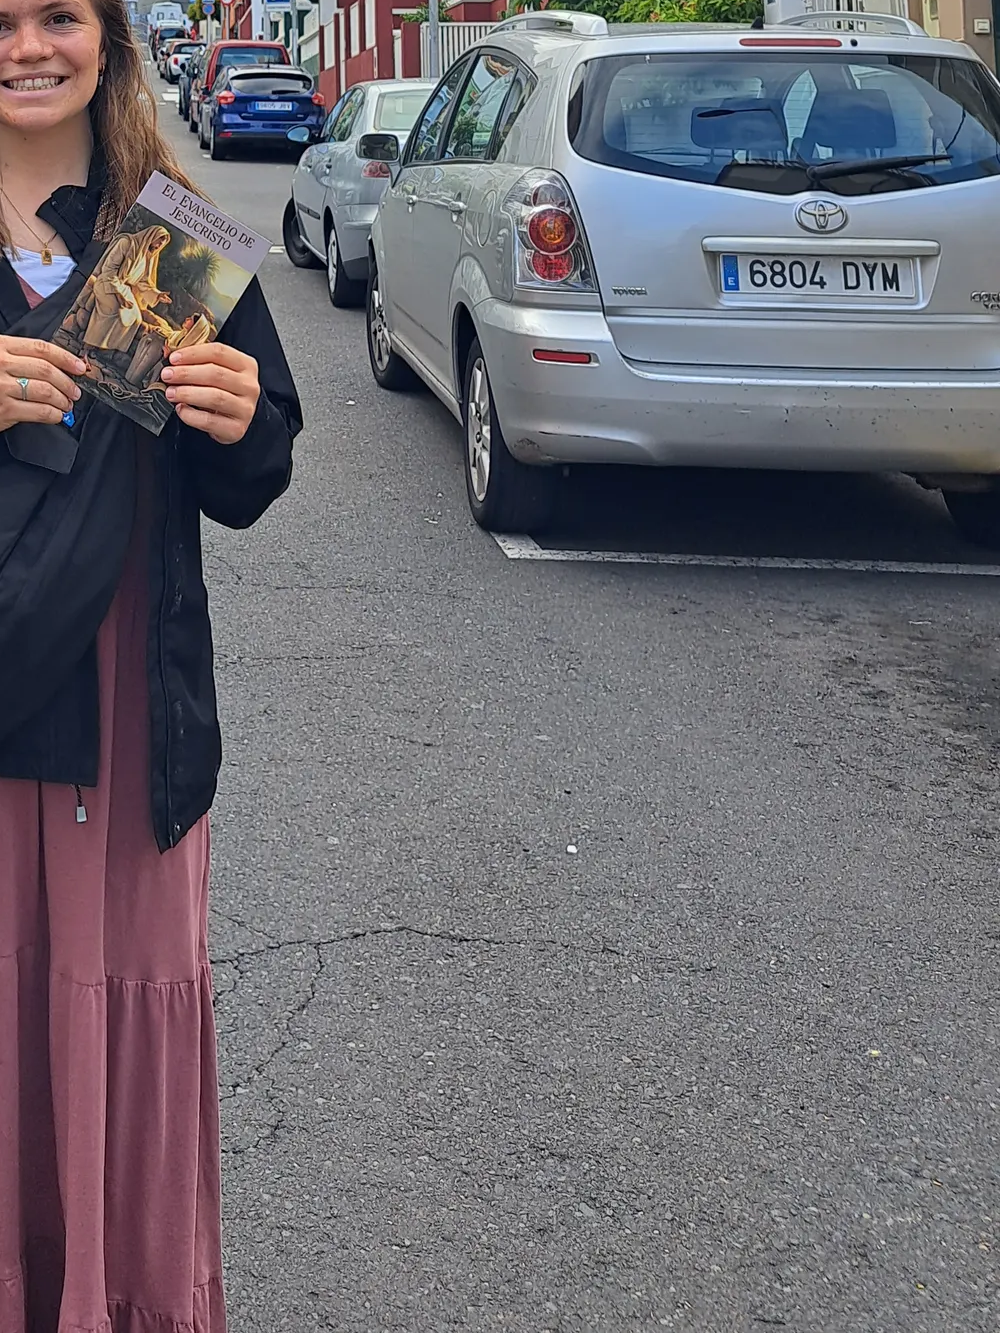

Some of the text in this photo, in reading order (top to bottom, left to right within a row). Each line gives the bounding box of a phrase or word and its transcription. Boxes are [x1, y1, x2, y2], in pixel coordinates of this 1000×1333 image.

[161, 183, 256, 249] EL EVANGELIO DE
[169, 206, 232, 251] JESUCRISTO
[749, 259, 828, 290] 6804
[842, 260, 901, 292] DYM
